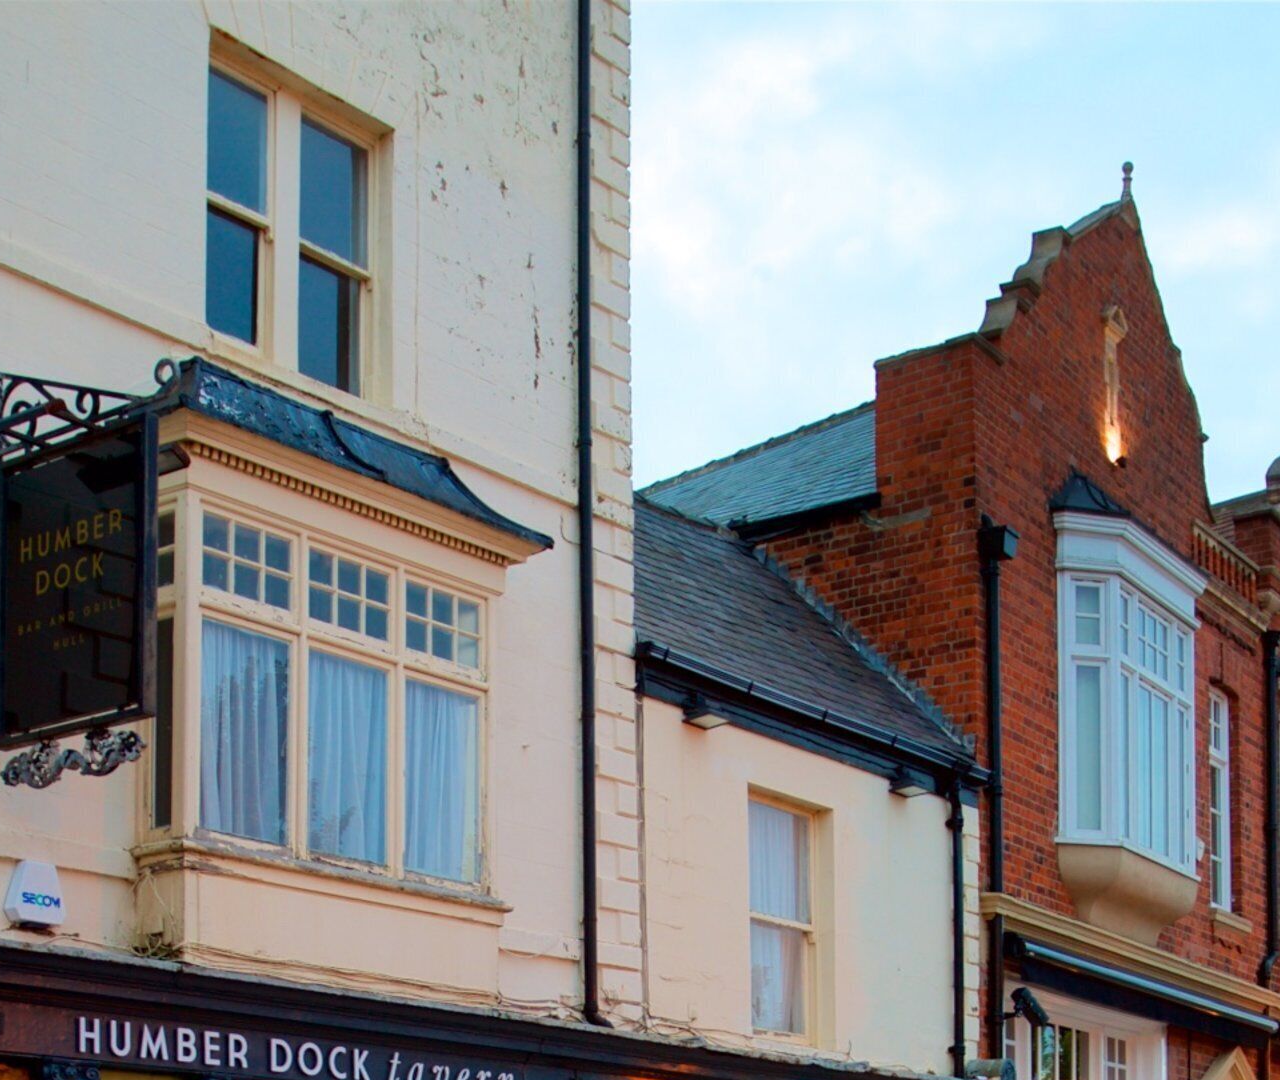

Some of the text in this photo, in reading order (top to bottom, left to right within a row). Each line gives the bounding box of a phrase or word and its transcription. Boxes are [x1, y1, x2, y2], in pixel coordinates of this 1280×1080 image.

[19, 508, 123, 564] HUMBER
[34, 551, 105, 596] DOCK
[17, 598, 122, 636] BAR AND GRILL
[53, 633, 85, 651] HULL
[78, 1016, 249, 1069] HUMBER
